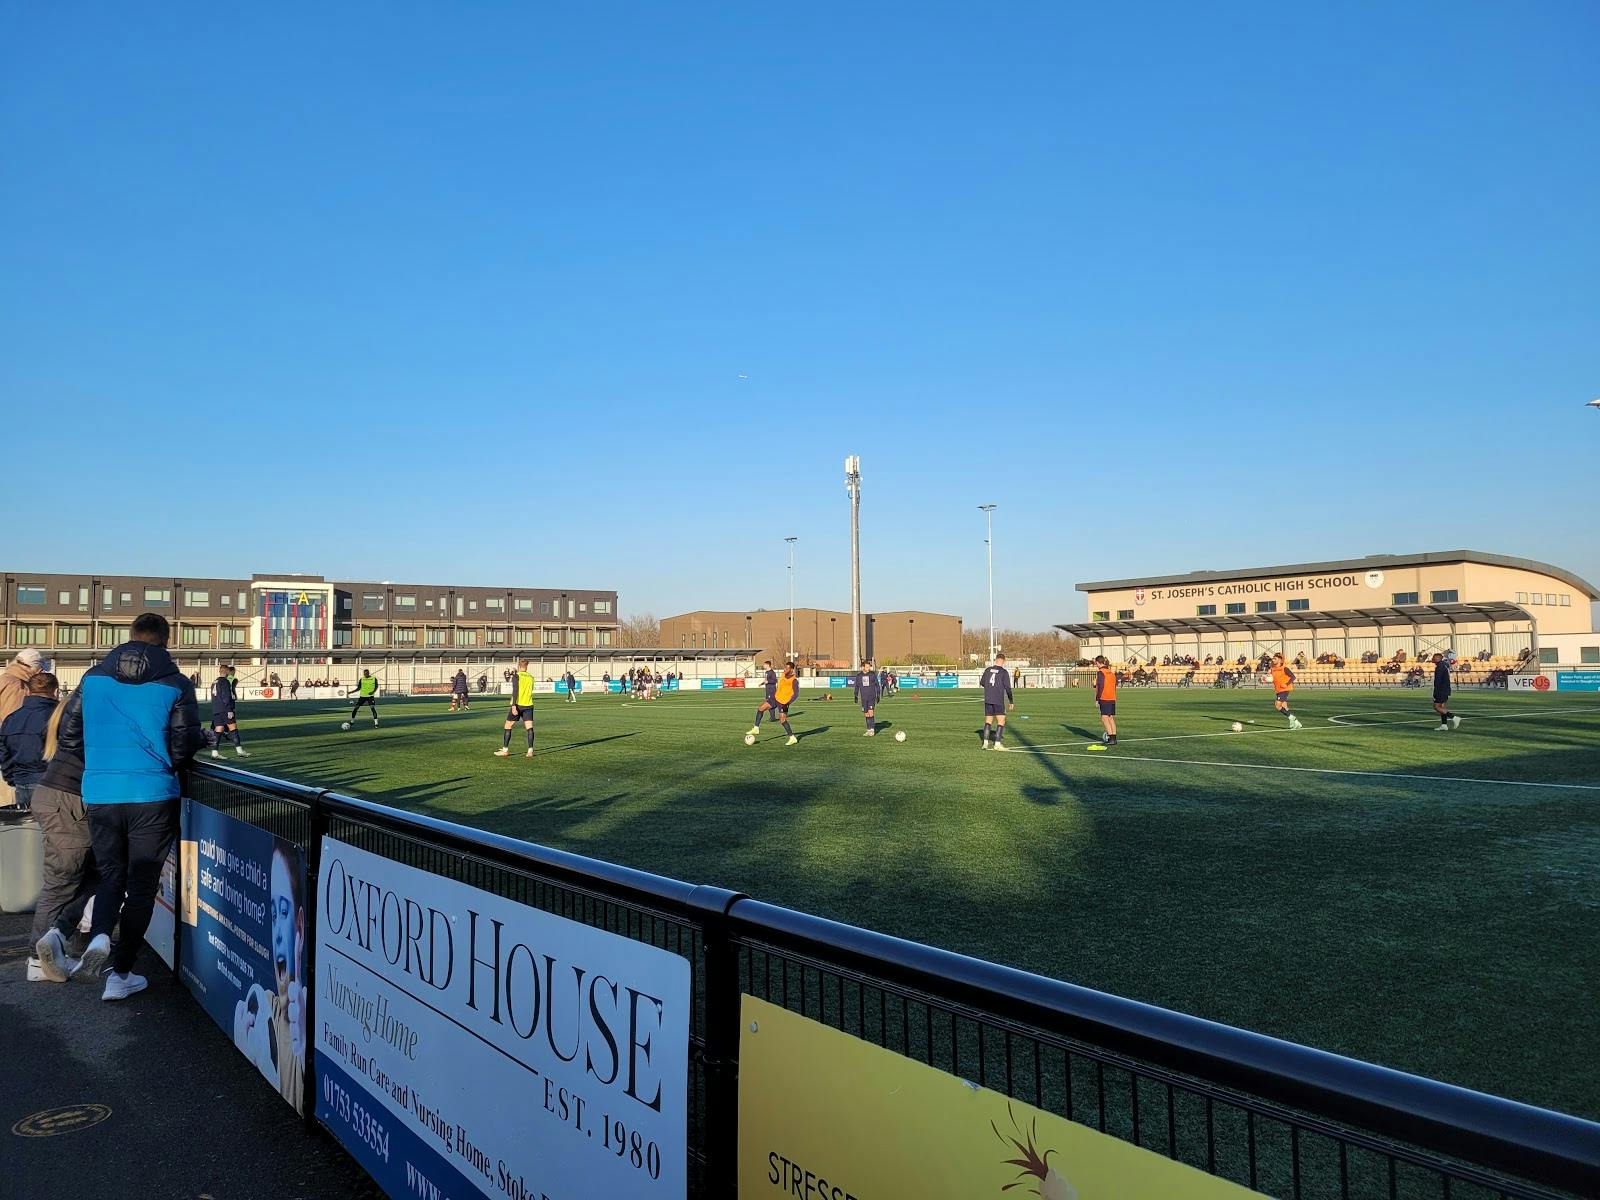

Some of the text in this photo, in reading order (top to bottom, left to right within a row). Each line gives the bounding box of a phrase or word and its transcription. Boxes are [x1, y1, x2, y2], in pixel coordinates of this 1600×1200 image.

[1151, 576, 1359, 600] ST. JOSEPH'S CATHOLIC HIGH SCHOOL
[249, 688, 274, 697] VERUS
[989, 673, 996, 686] 4
[1514, 678, 1550, 687] VERUS
[200, 838, 267, 890] could you give a child a
[200, 867, 212, 890] safe
[212, 876, 224, 897] and
[225, 878, 243, 914] loving
[243, 890, 266, 926] home?
[324, 963, 418, 1061] Nursing Home
[326, 859, 663, 1113] OXFORD HOUSE
[323, 1073, 350, 1123] 01753
[352, 1101, 390, 1164] 533554
[324, 1021, 349, 1064] Family
[350, 1041, 367, 1075] Run
[369, 1057, 390, 1094] Care
[391, 1080, 408, 1110] and
[411, 1089, 453, 1154] Nursing
[456, 1123, 494, 1187] Home,
[543, 1077, 661, 1180] EST. 1980
[768, 1151, 858, 1200] STRES
